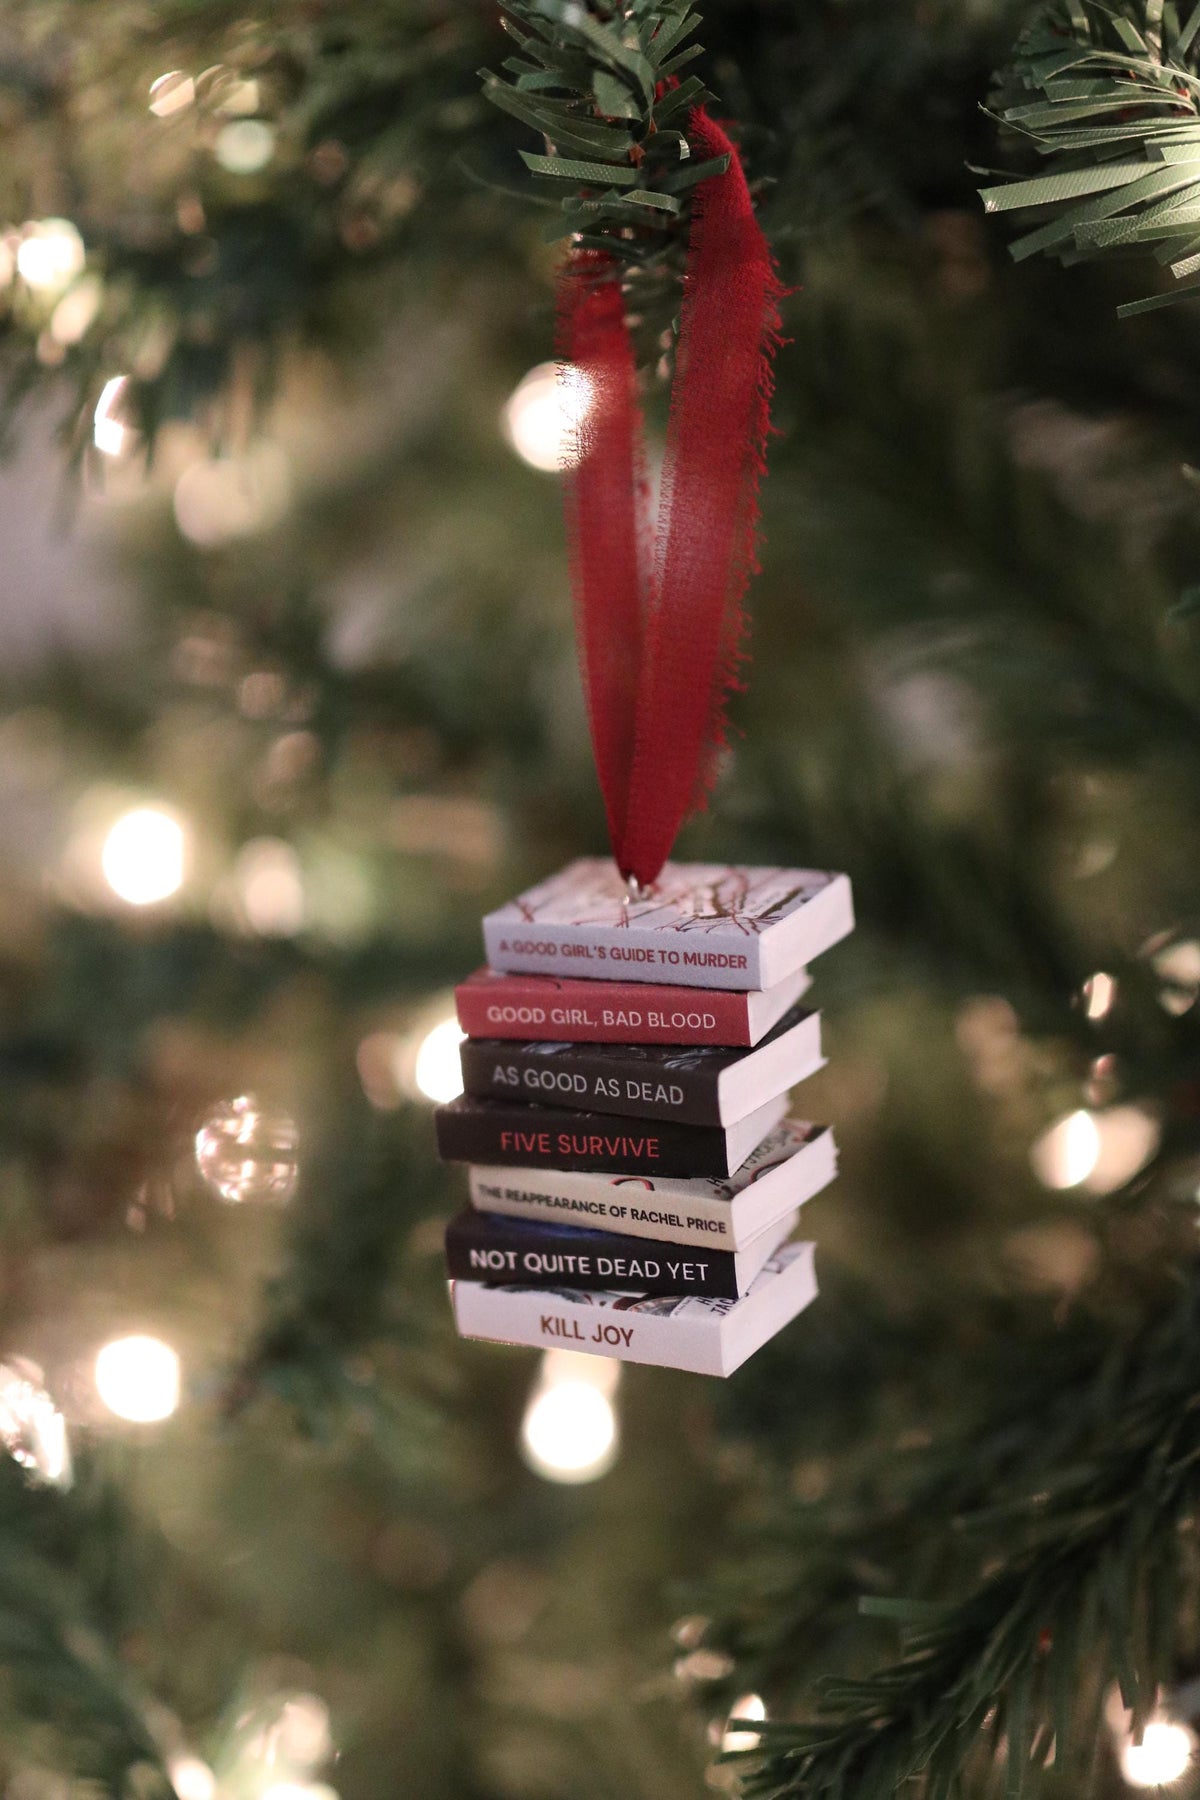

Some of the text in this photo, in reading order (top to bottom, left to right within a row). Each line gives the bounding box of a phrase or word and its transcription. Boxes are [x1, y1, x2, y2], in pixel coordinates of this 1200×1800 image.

[501, 940, 748, 969] A GOOD GIRL'S GUIDE TO MURDER
[487, 1005, 717, 1029] GOOD GIRL, BAD BLOOD
[492, 1065, 685, 1105] AS GOOD AS DEAD
[500, 1131, 660, 1158] FIVE SURVIVE
[477, 1183, 727, 1234] THE REAPPEARANCE OF RACHEL PRICE
[469, 1249, 709, 1282] NOT QUITE DEAD YET
[540, 1315, 635, 1348] KILL JOY
